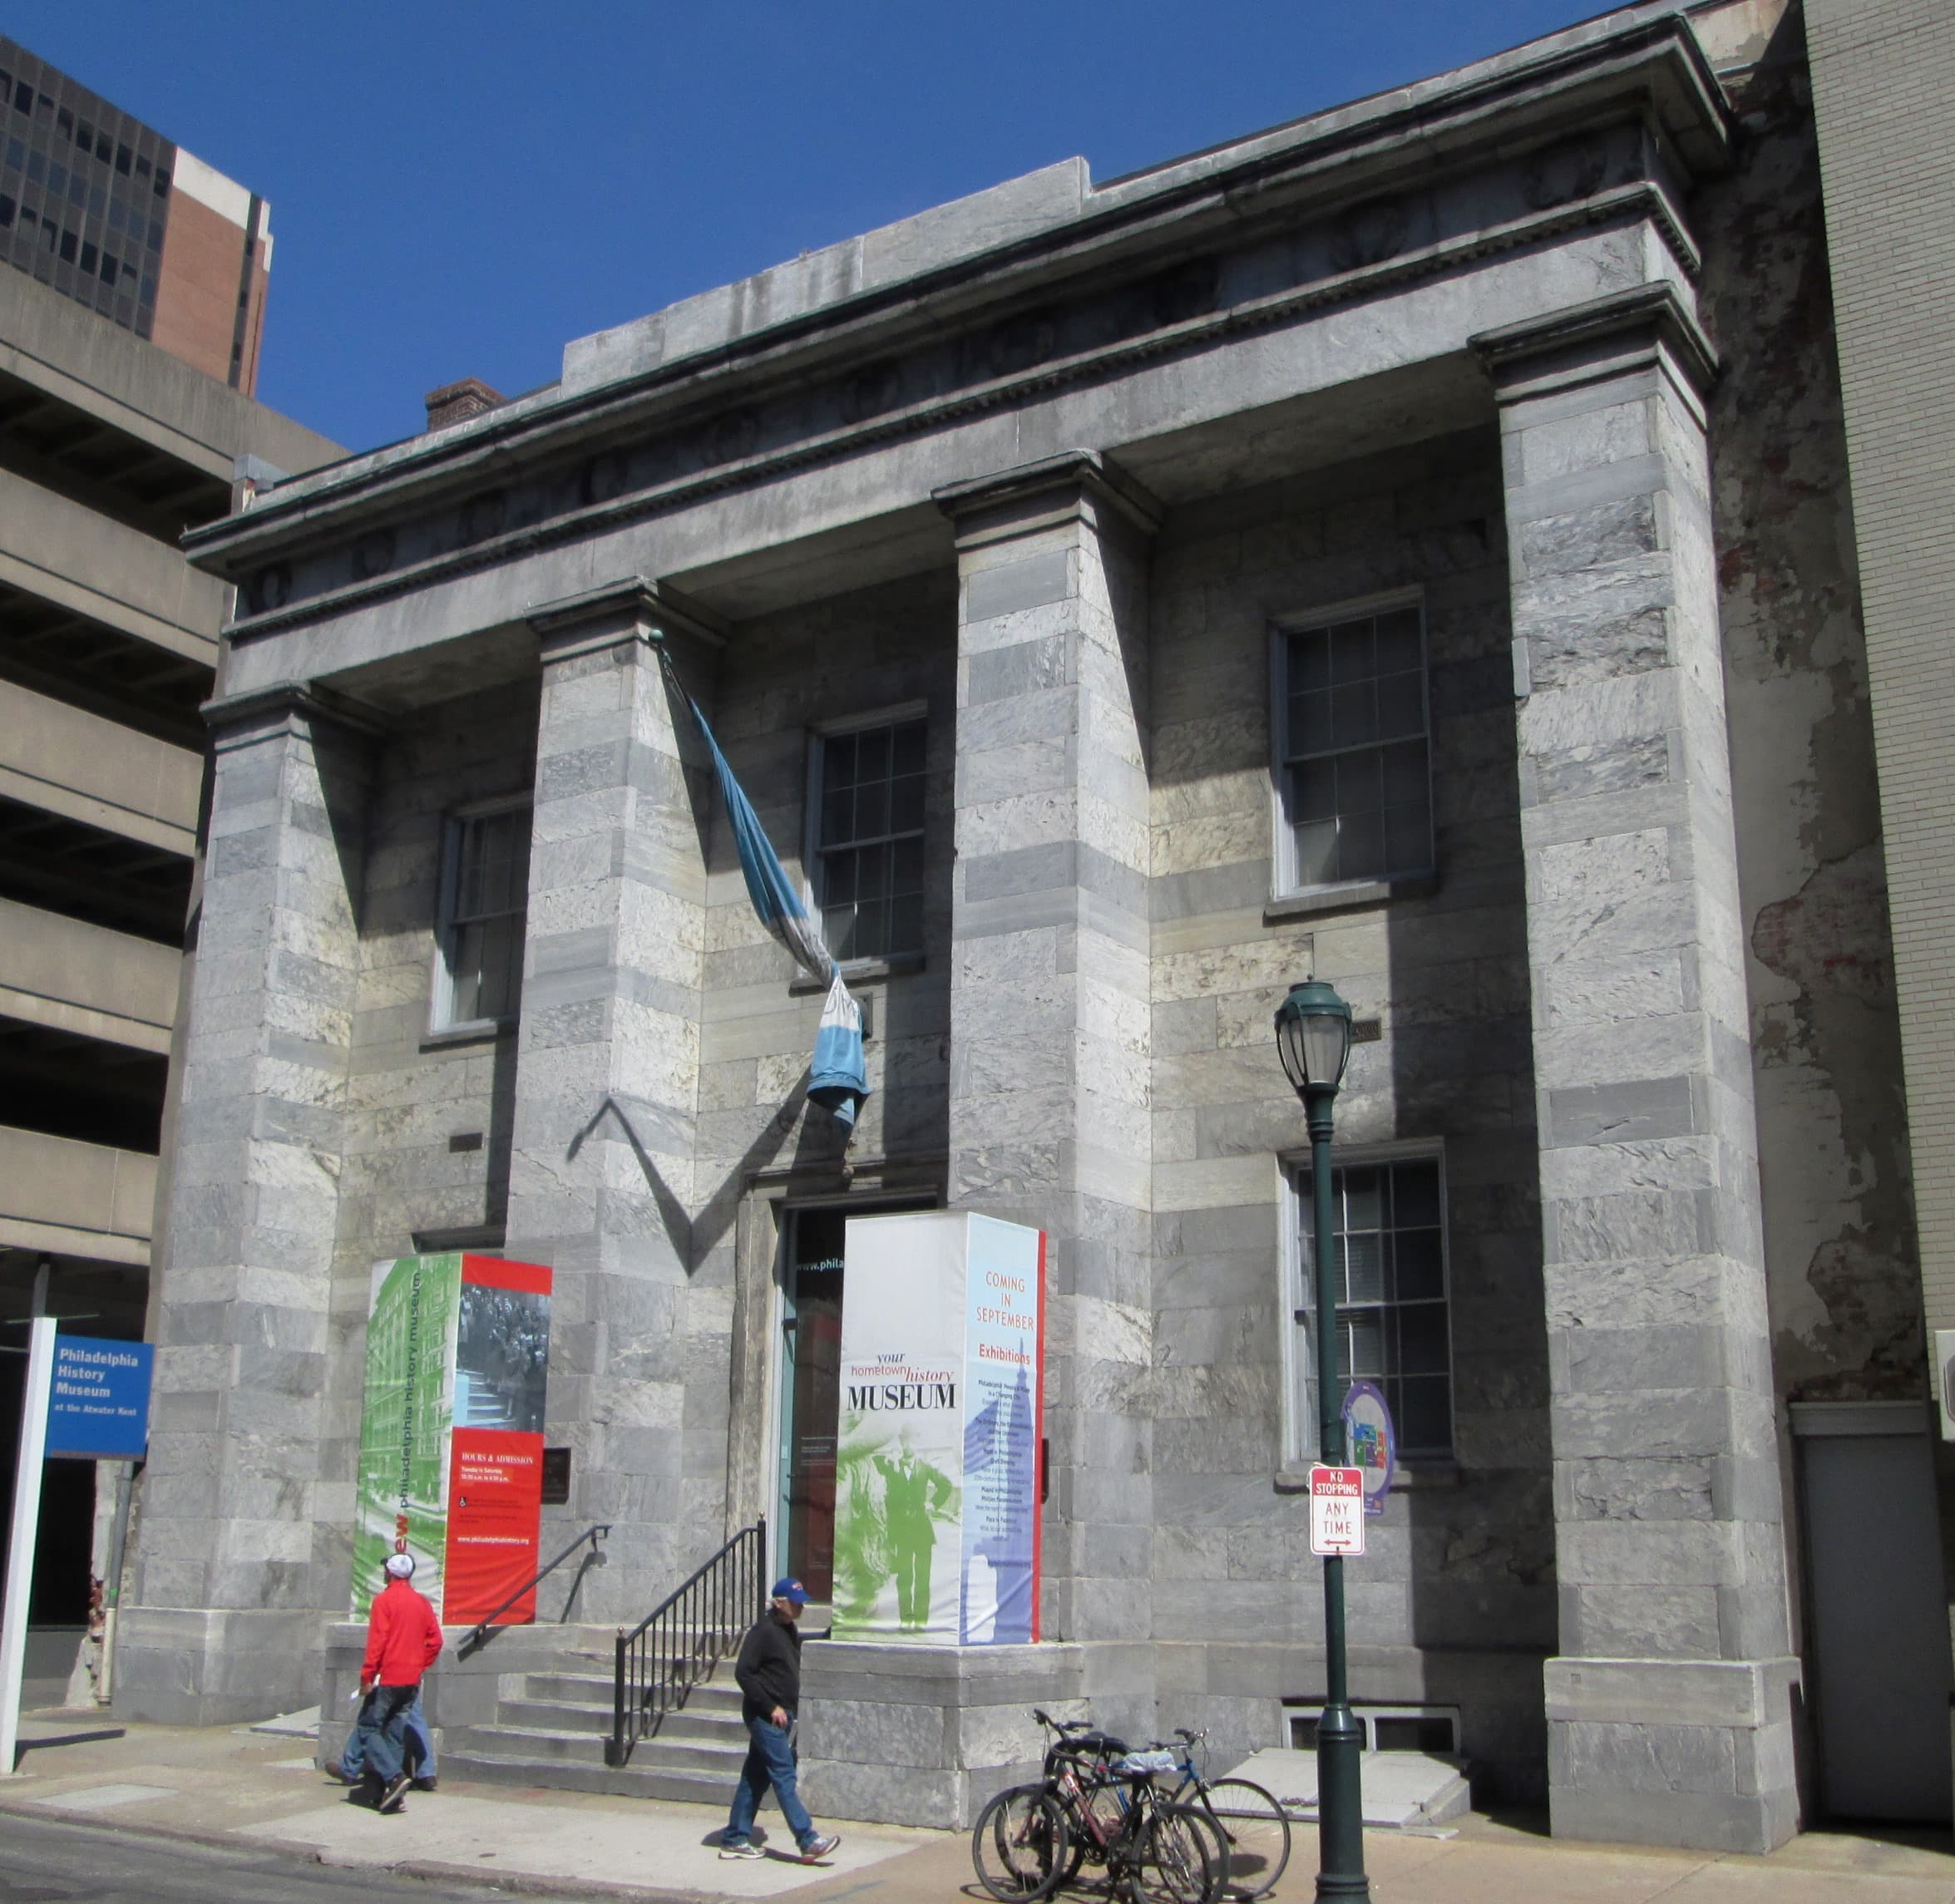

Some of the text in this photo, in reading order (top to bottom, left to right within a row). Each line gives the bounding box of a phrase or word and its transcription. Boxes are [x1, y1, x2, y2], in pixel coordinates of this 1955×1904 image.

[797, 1258, 844, 1272] www.phila
[985, 1270, 1025, 1293] COMING
[1000, 1293, 1011, 1308] IN
[976, 1306, 1034, 1331] SEPTEMBER
[59, 1348, 139, 1368] Philadelphia
[877, 1354, 906, 1364] your
[979, 1343, 1031, 1365] Exhibitions
[57, 1364, 106, 1383] History
[852, 1365, 955, 1382] hometown history
[56, 1381, 111, 1398] Museum
[846, 1383, 957, 1412] MUSEUM
[67, 1404, 81, 1413] the
[84, 1405, 115, 1414] Atwater
[118, 1407, 137, 1417] Kent
[395, 1272, 421, 1554] ew philadelphia history museum
[462, 1453, 533, 1464] HOURS & ADMISSION
[1330, 1471, 1344, 1482] NO
[1316, 1482, 1358, 1495] STOPPING
[1326, 1502, 1349, 1516] ANY
[1323, 1521, 1351, 1535] TIME
